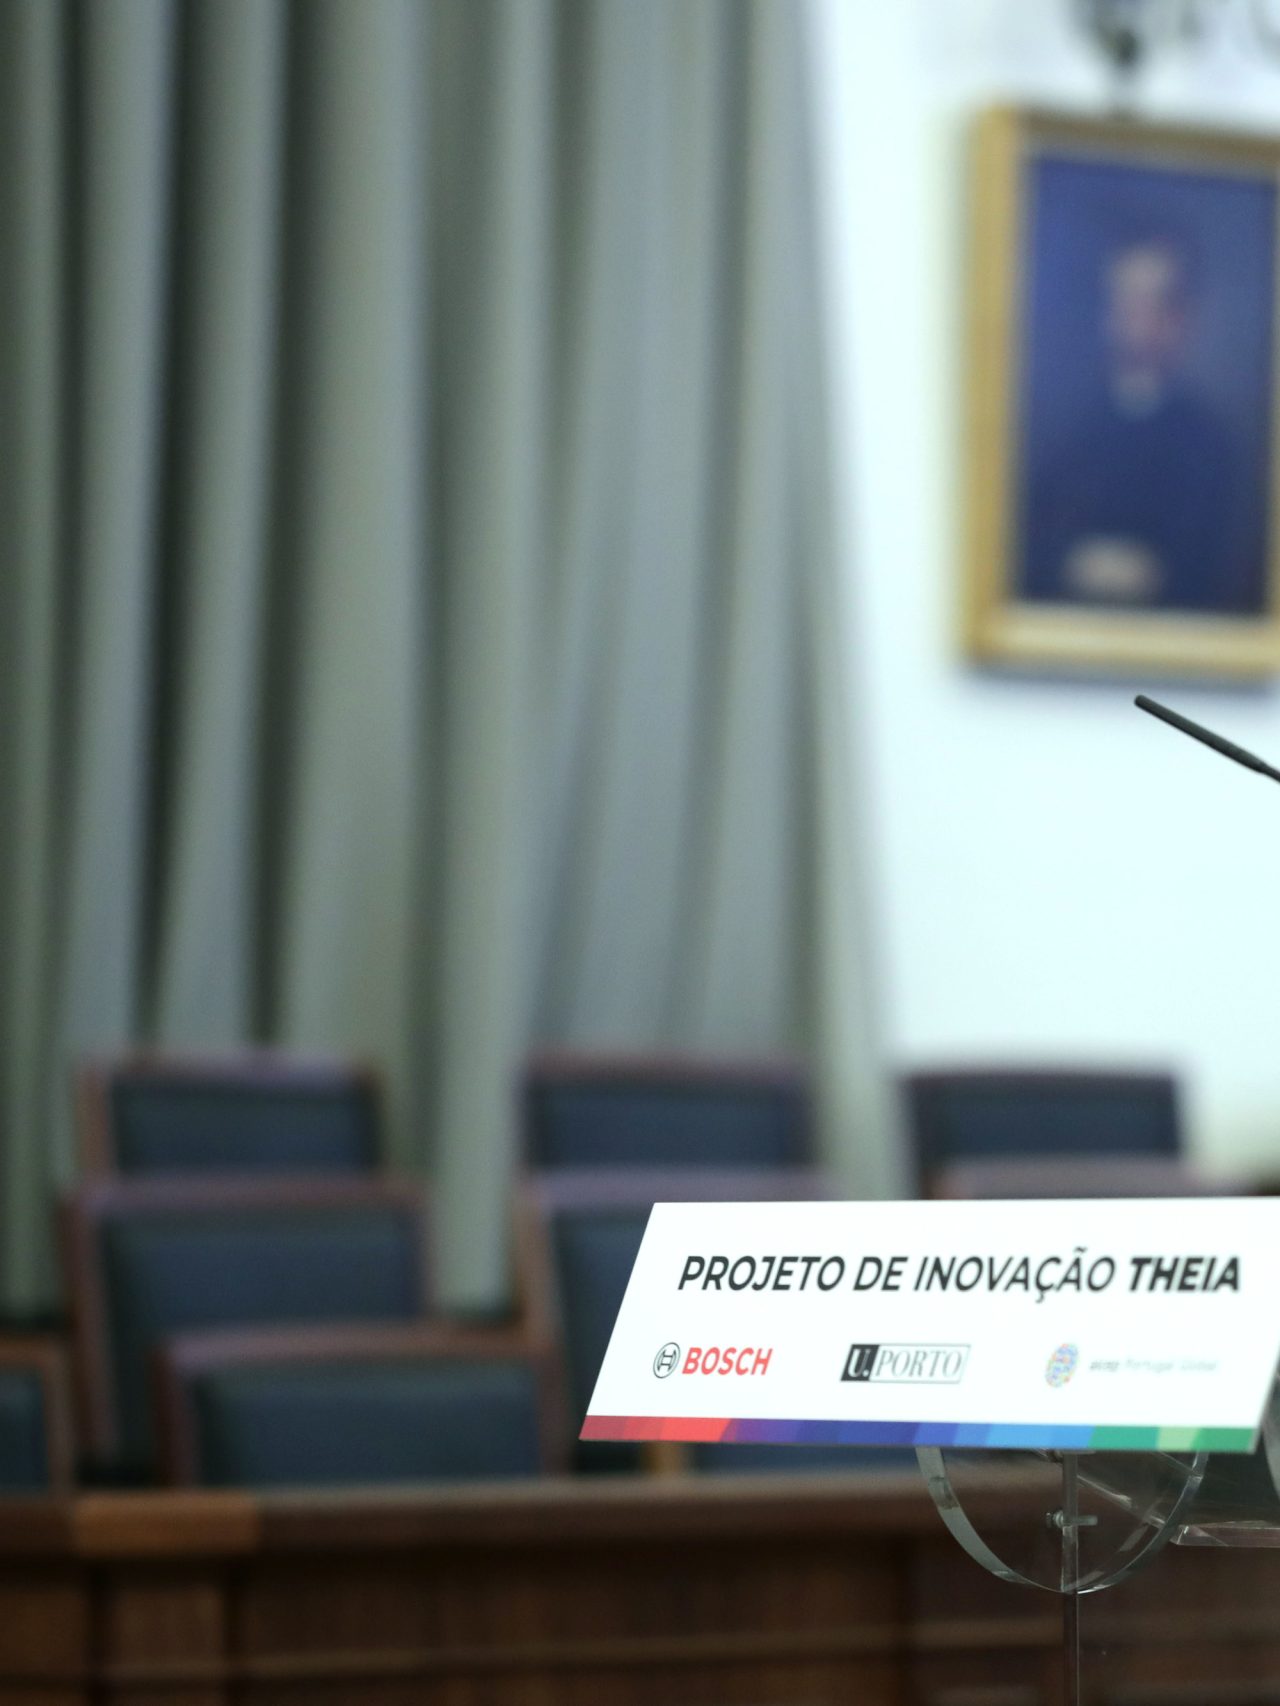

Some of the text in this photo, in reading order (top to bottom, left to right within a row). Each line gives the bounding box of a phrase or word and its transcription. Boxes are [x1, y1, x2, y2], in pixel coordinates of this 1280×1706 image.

[677, 1246, 1241, 1303] PROJETO DE INOVAÇÃO THEIA
[681, 1346, 773, 1376] BOSCH
